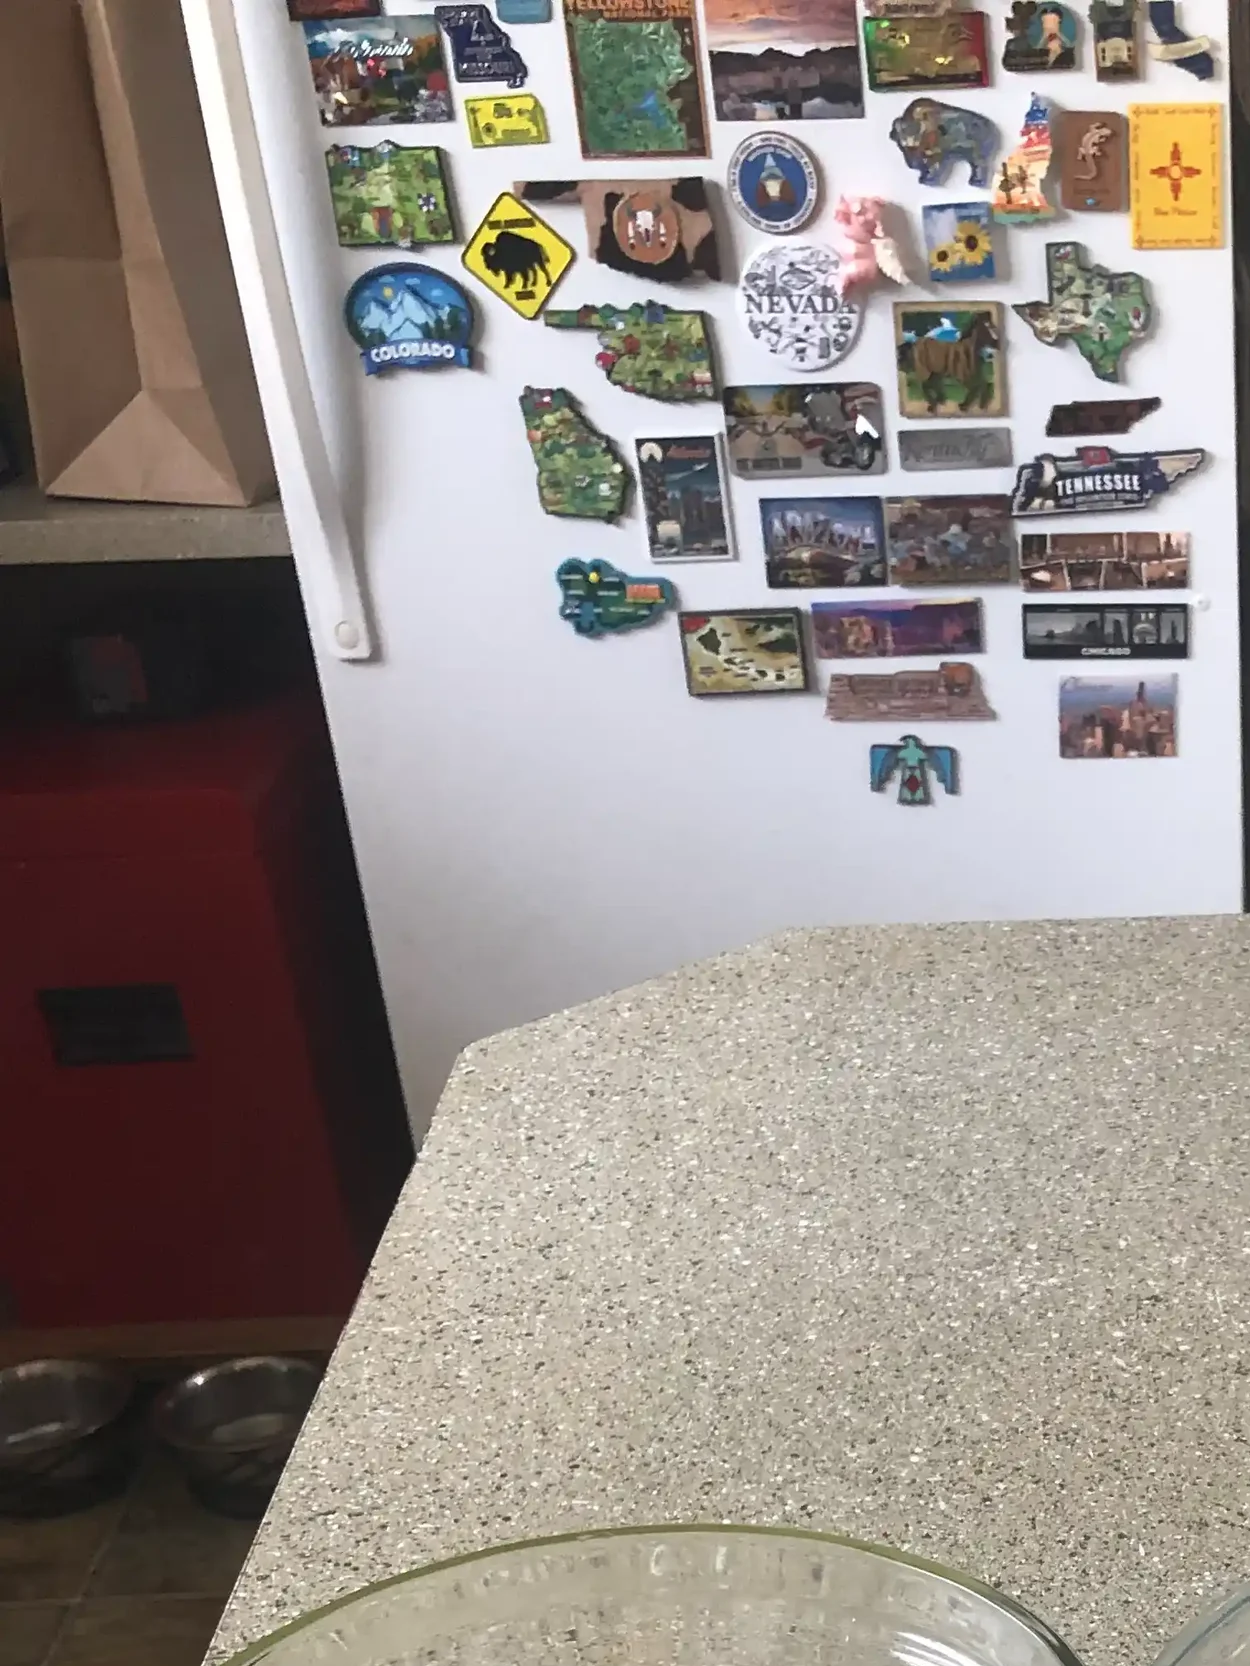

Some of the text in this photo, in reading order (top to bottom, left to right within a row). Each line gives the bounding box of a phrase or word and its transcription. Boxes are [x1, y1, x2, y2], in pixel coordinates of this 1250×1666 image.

[566, 0, 690, 10] YELLOWSTONE
[371, 341, 455, 363] COLORADO
[1056, 474, 1141, 496] TENNESSEE
